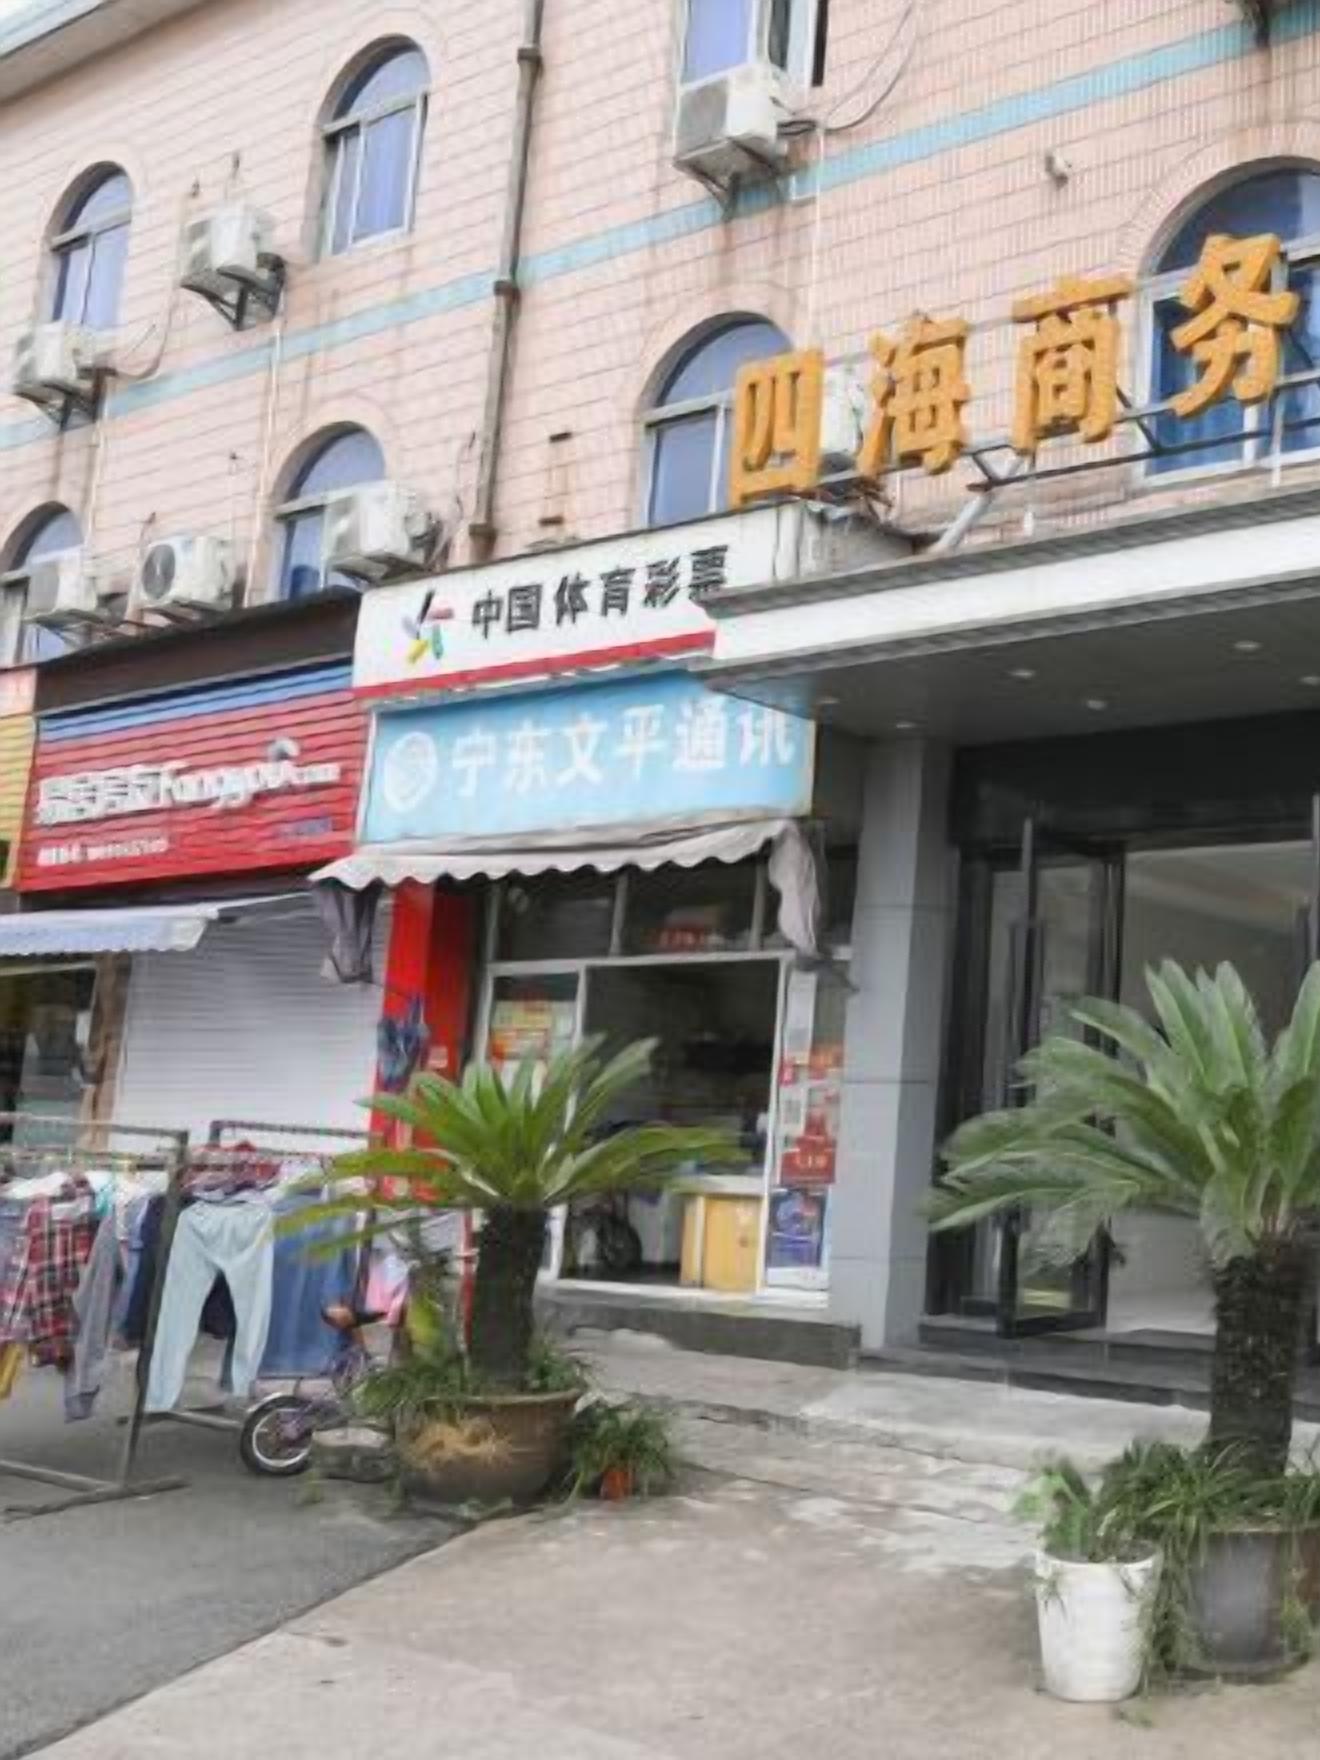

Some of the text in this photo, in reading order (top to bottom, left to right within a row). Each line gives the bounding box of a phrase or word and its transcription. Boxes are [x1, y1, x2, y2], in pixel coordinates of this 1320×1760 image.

[471, 544, 729, 640] 中国体育彩票
